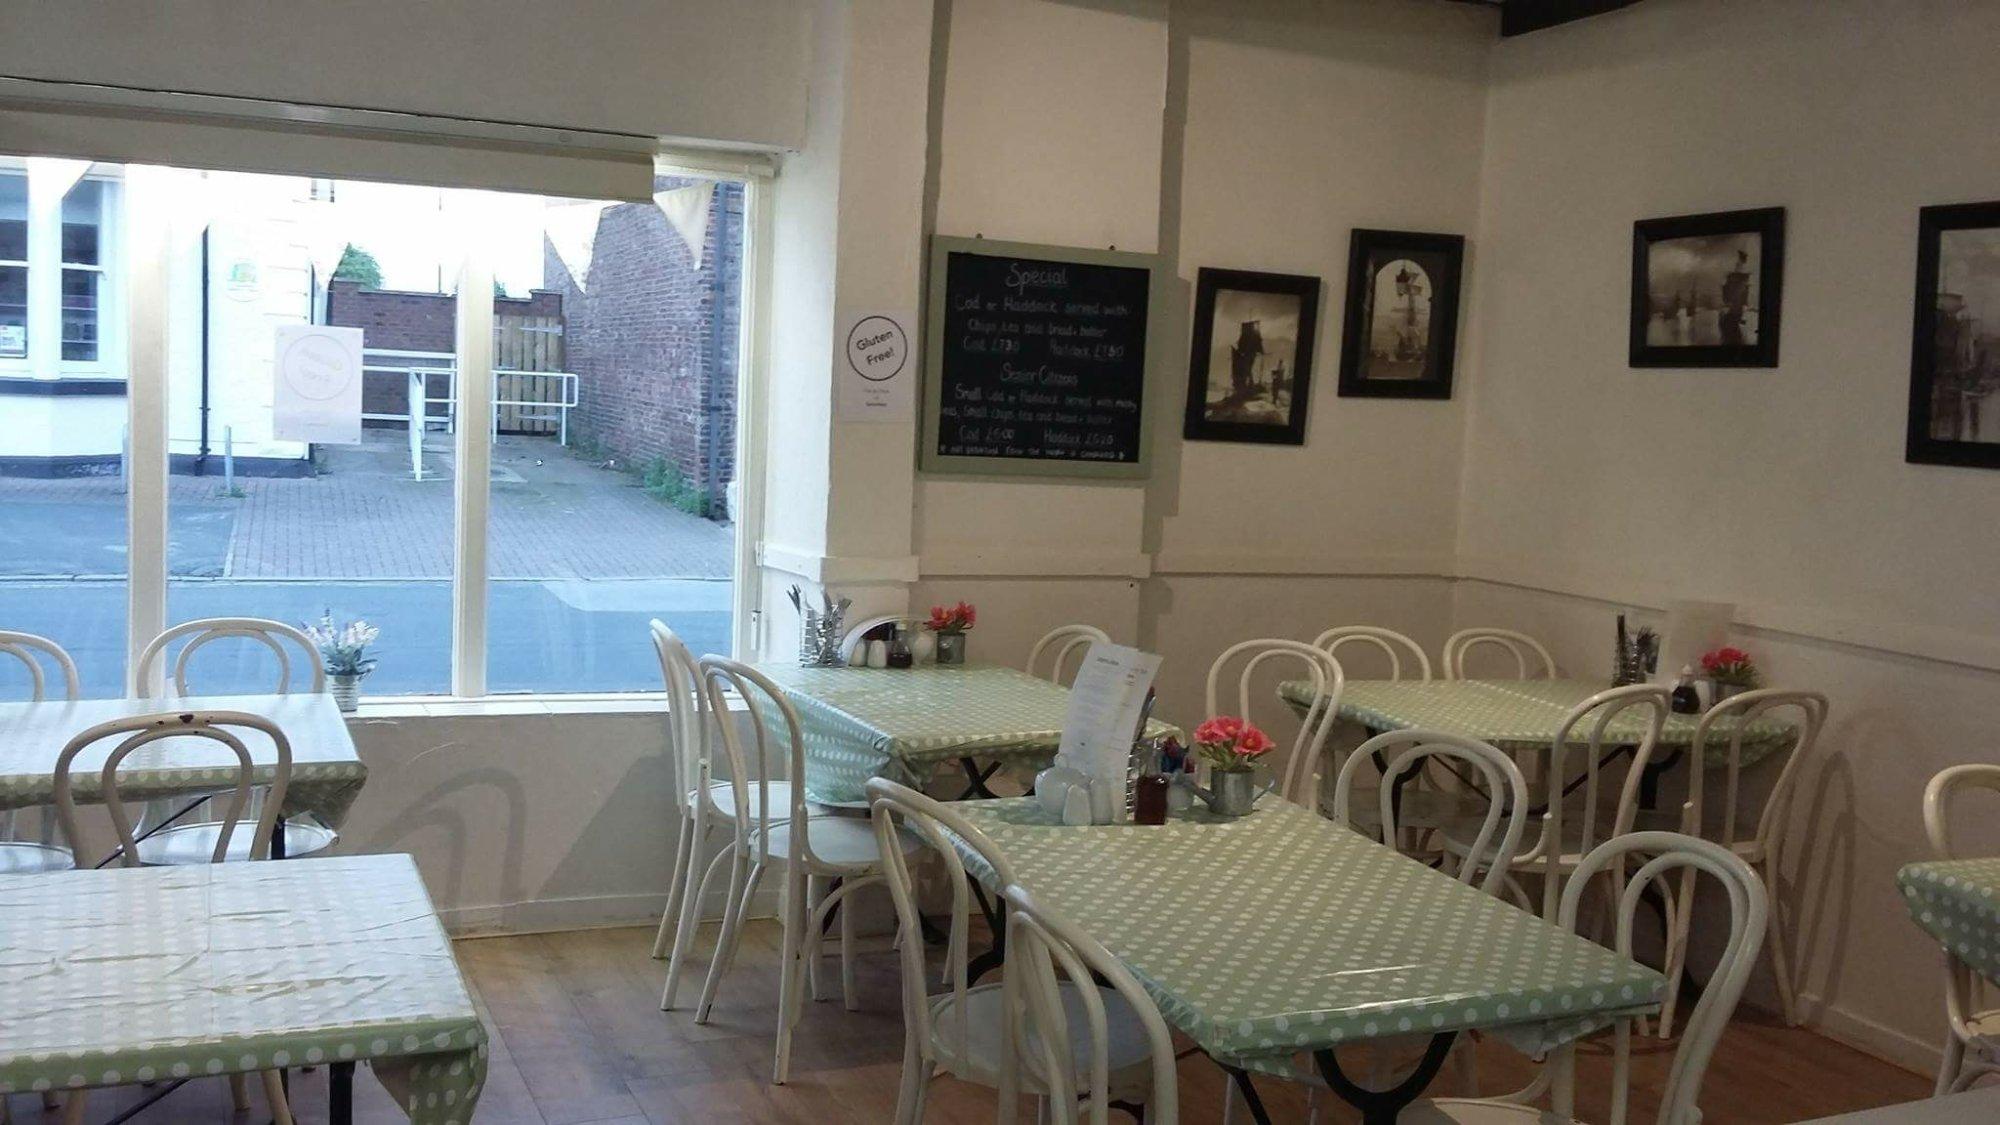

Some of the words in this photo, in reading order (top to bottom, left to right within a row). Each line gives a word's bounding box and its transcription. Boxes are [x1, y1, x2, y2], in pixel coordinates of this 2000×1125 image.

[1006, 262, 1068, 294] Special
[955, 294, 980, 311] Cod
[1004, 297, 1057, 313] Haddock
[1065, 302, 1099, 314] served
[1102, 304, 1129, 316] with
[856, 331, 893, 350] Gluten
[963, 336, 986, 352] Cod
[1050, 338, 1090, 357] Haddock
[866, 347, 895, 365] Free!
[1000, 362, 1037, 383] Senior
[955, 383, 982, 401] Small
[1020, 389, 1058, 404] Haddock
[959, 426, 979, 441] Cod
[1044, 429, 1082, 444] Haddock
